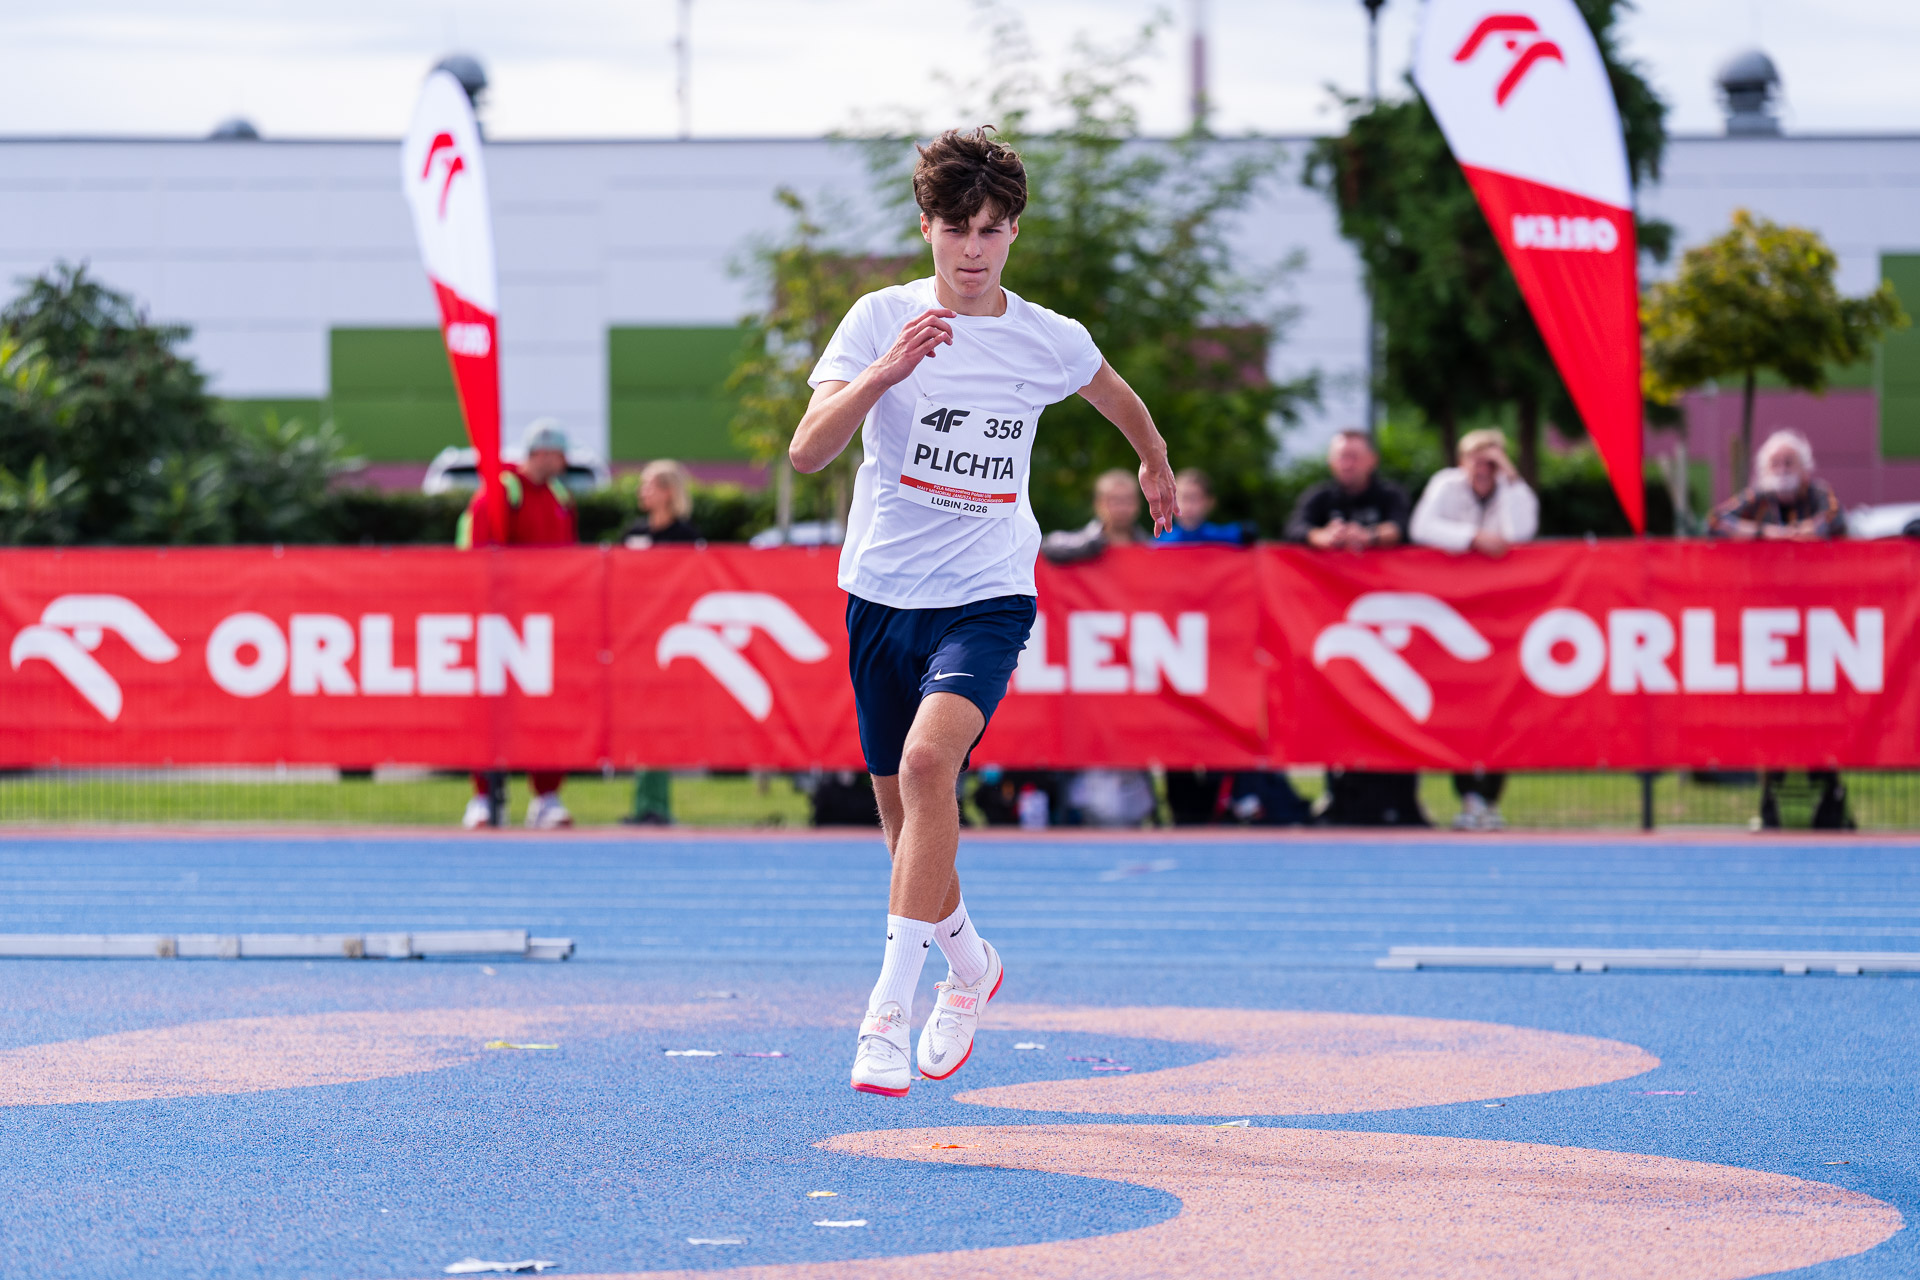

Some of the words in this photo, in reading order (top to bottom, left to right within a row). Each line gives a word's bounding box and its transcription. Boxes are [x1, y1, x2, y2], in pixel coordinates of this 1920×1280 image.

[920, 407, 971, 434] 4F
[983, 418, 1024, 440] 358
[913, 443, 1014, 480] PLICHTA
[930, 496, 961, 509] LUBIN
[962, 502, 988, 514] 2026
[206, 612, 553, 696] ORLEN
[1013, 611, 1208, 695] LEN
[1520, 608, 1884, 696] ORLEN
[946, 993, 977, 1010] NIKE
